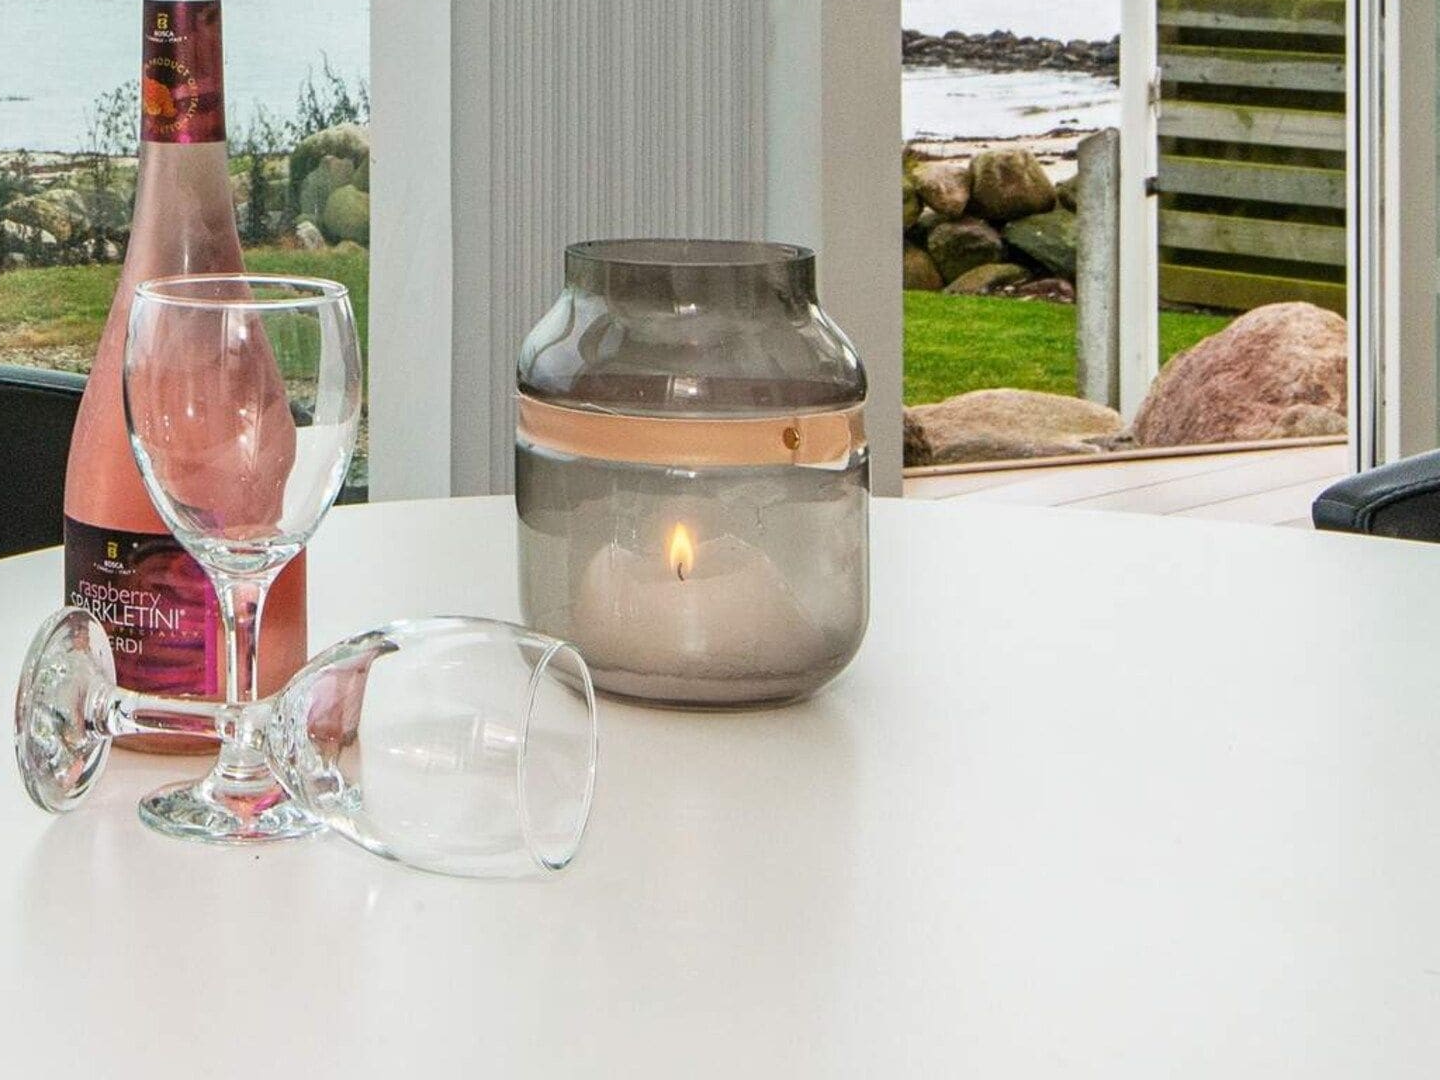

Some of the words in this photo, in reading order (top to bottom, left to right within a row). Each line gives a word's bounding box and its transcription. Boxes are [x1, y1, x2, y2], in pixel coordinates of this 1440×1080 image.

[103, 560, 125, 569] BOSCA
[79, 580, 161, 609] raspberry
[107, 635, 143, 656] ERDI
